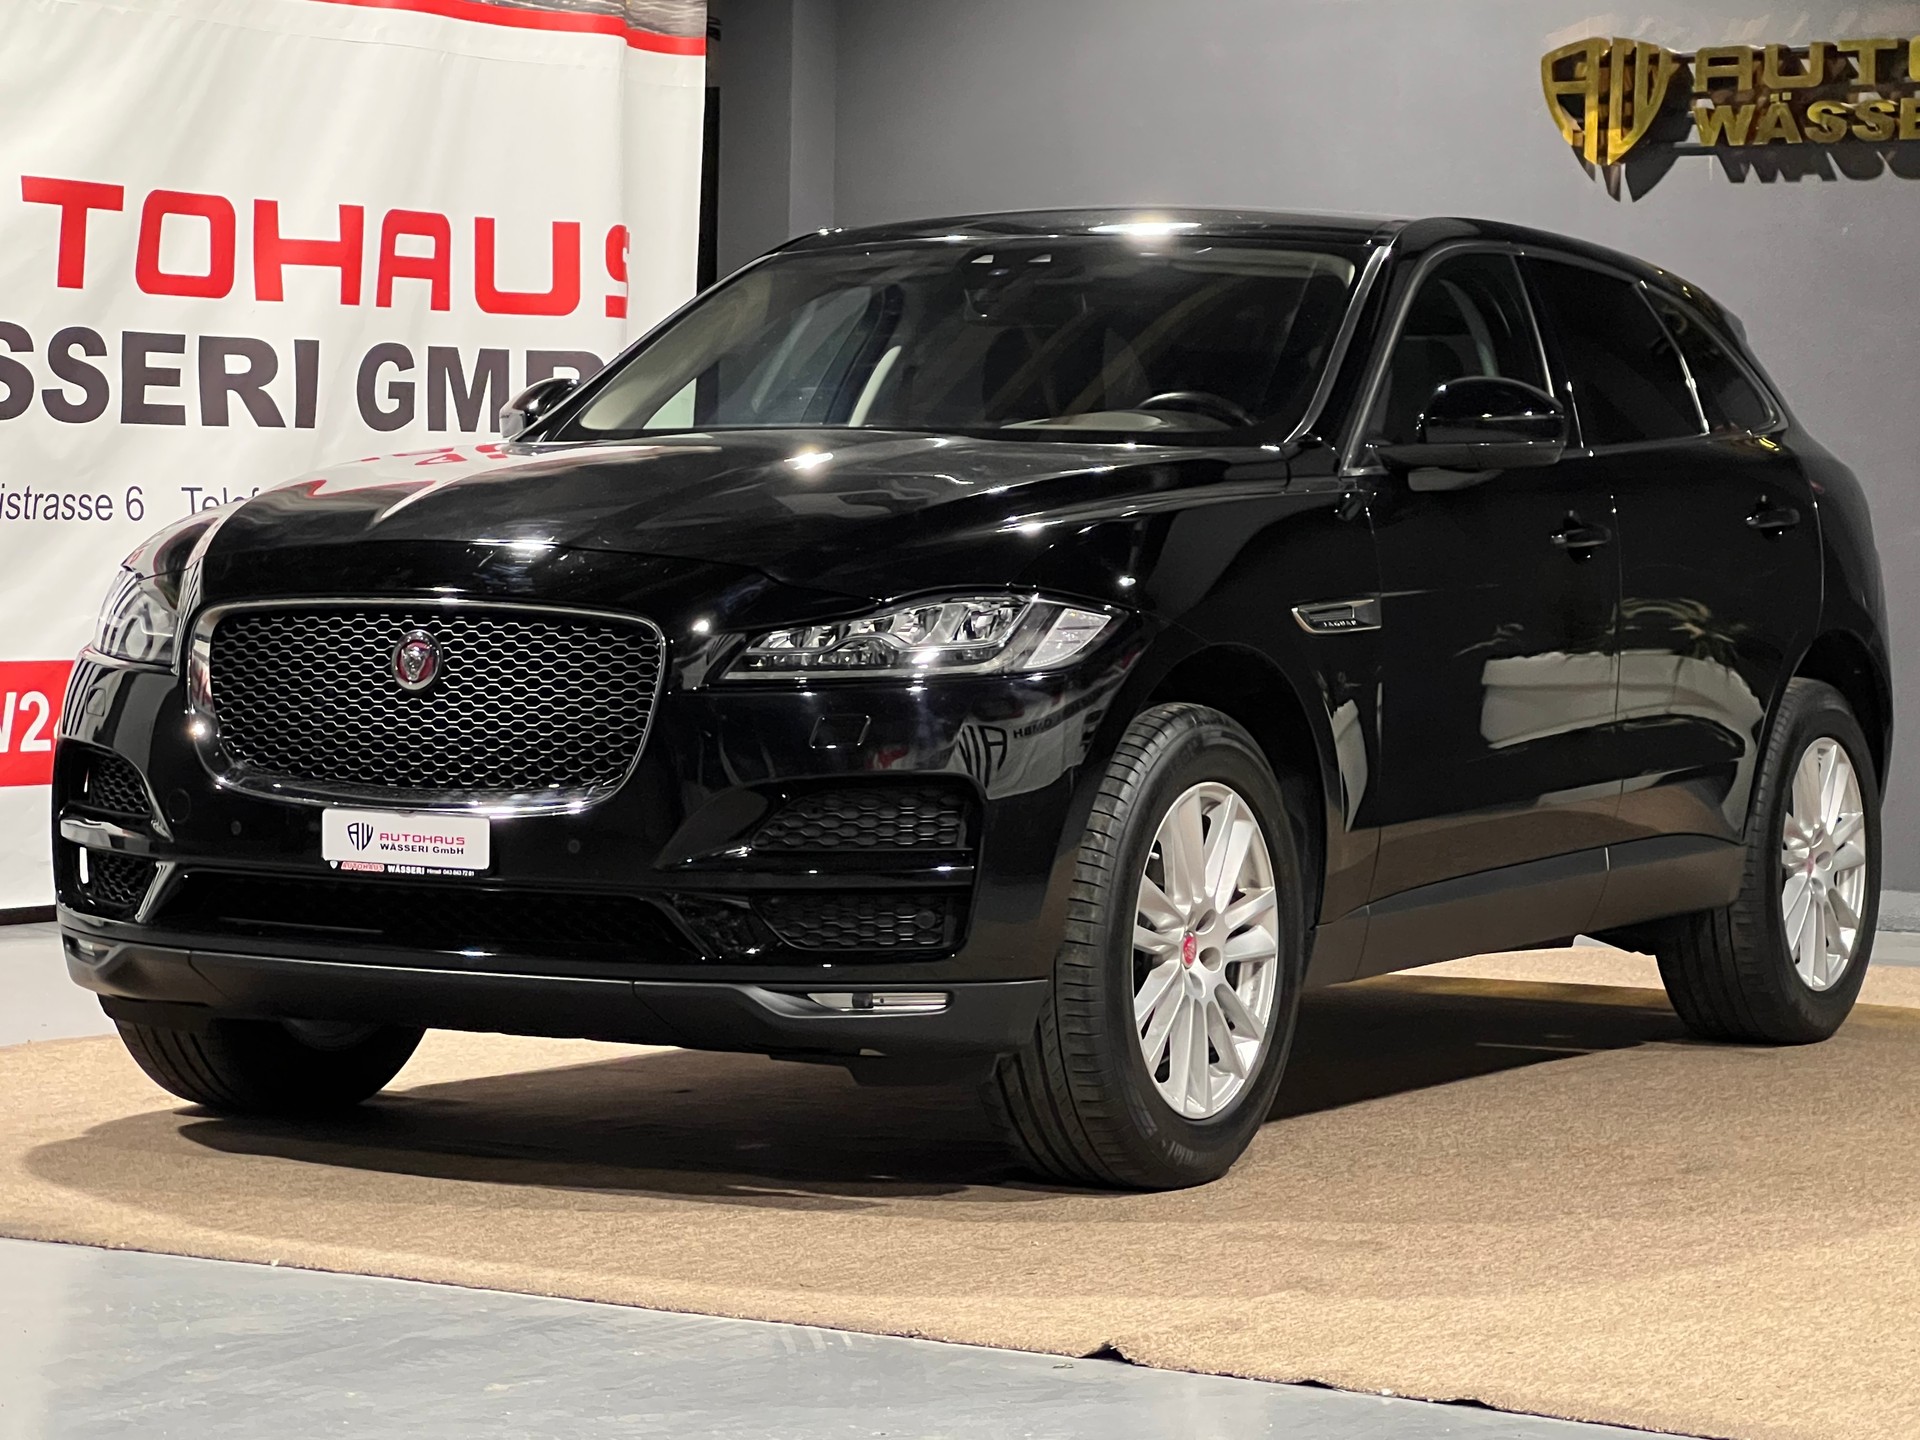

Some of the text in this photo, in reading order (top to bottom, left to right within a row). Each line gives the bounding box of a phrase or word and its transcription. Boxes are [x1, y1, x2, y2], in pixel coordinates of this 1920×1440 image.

[1692, 35, 1920, 92] AUT
[126, 486, 145, 522] 6
[379, 832, 465, 845] AUTOHAUS
[380, 842, 465, 855] WÄSSERI GmbH
[341, 861, 384, 872] AUTOHAUS
